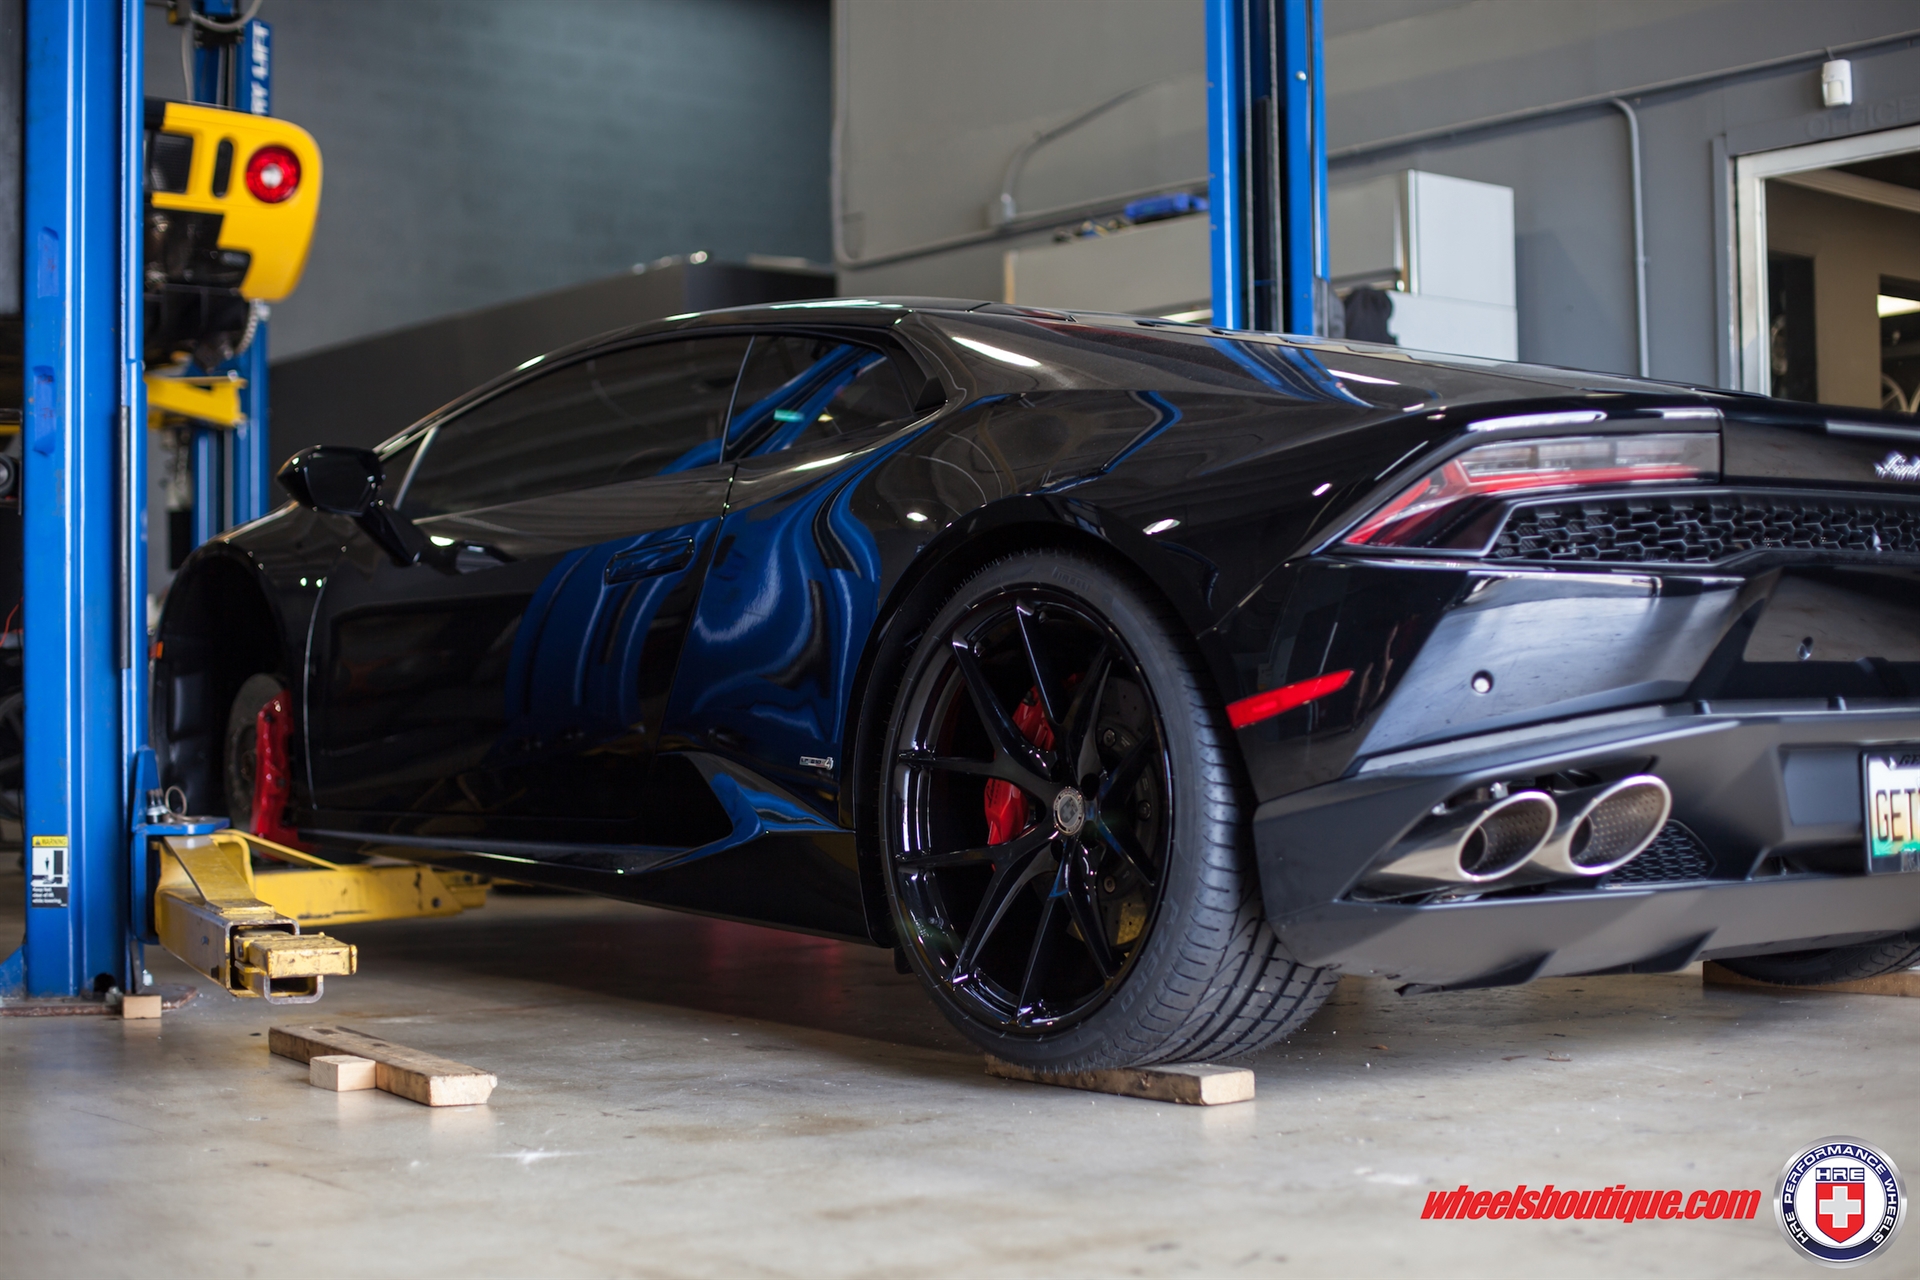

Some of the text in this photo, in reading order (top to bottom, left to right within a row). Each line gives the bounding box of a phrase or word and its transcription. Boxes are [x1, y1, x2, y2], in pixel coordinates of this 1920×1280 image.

[252, 20, 269, 80] LIFT
[41, 837, 67, 846] WARNING
[1875, 788, 1920, 842] GET
